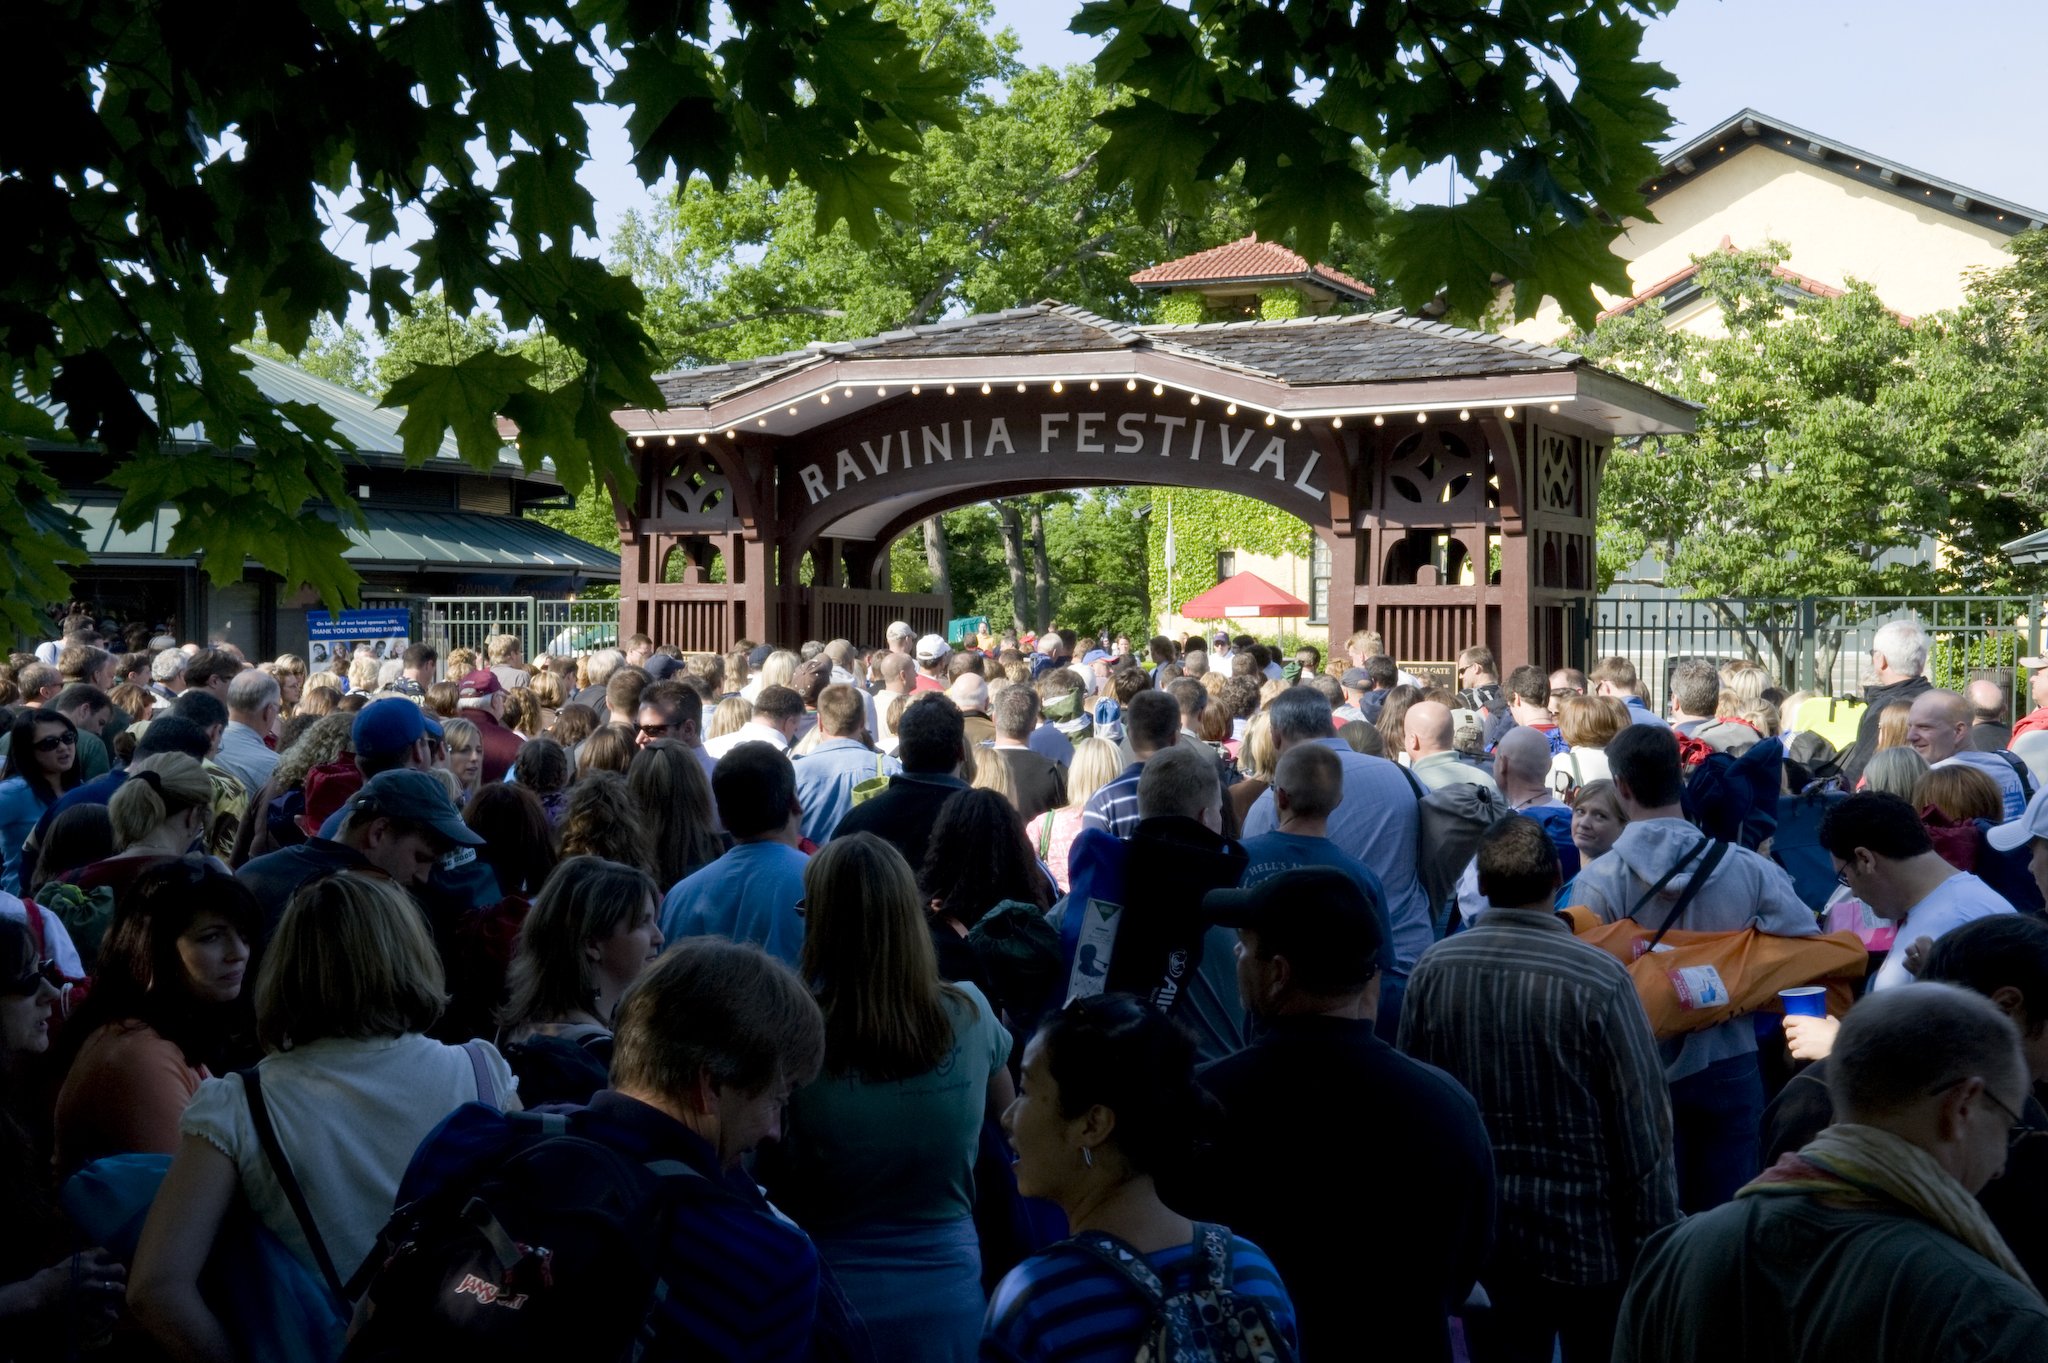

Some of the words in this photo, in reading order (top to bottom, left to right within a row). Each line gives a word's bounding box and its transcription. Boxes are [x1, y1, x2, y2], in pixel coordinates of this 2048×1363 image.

[799, 417, 1017, 505] RAVINIA
[1039, 411, 1326, 502] FESTIVAL
[1249, 861, 1287, 876] HELL'S
